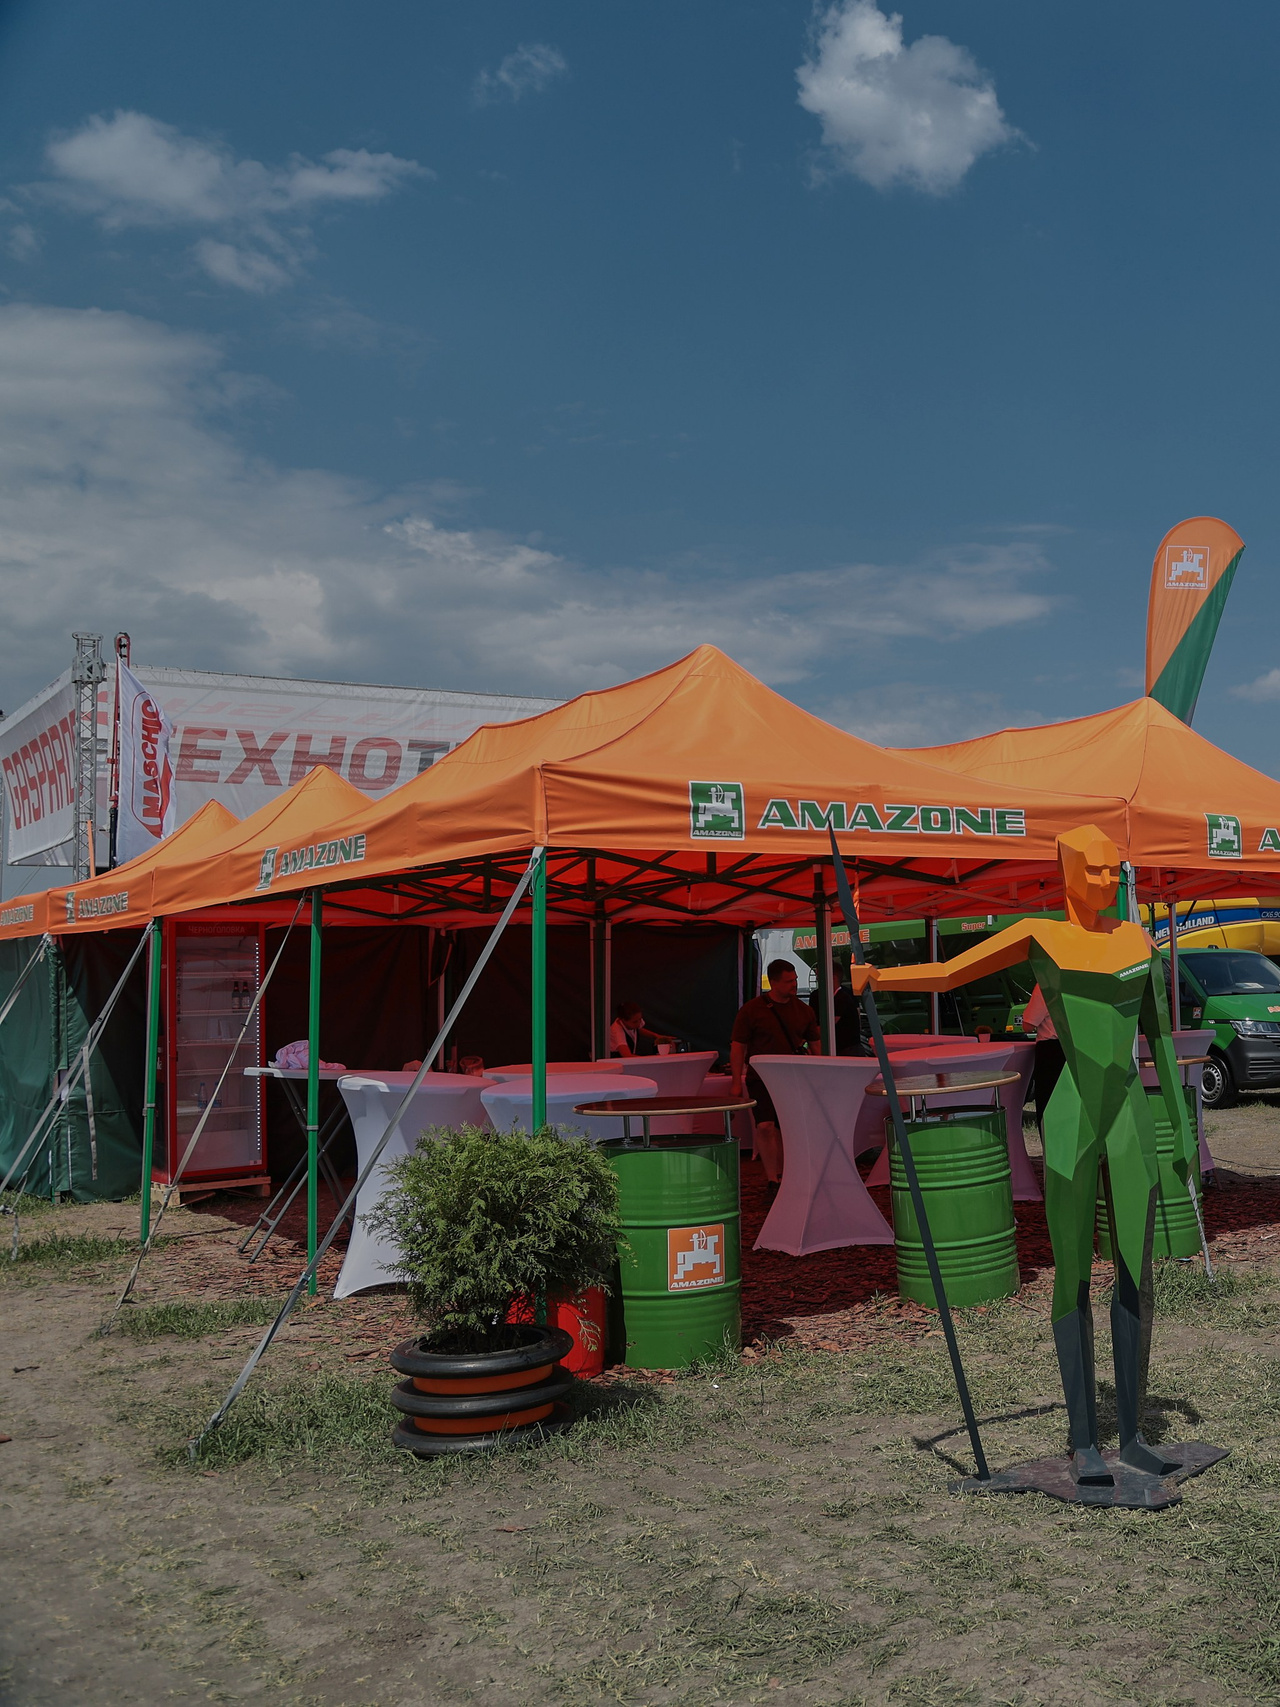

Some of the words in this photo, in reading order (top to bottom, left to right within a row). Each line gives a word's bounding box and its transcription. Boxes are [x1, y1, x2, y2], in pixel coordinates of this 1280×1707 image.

[141, 699, 162, 818] MASCHIO
[757, 799, 1026, 836] AMAZONE
[692, 829, 742, 837] AMAZONE
[276, 833, 366, 878] AMAZONE
[78, 891, 129, 918] AMAZONE
[961, 922, 985, 932] Super
[794, 929, 870, 950] AMZOE
[1120, 962, 1149, 978] AMAZONE
[670, 1275, 724, 1289] AMAZONE
